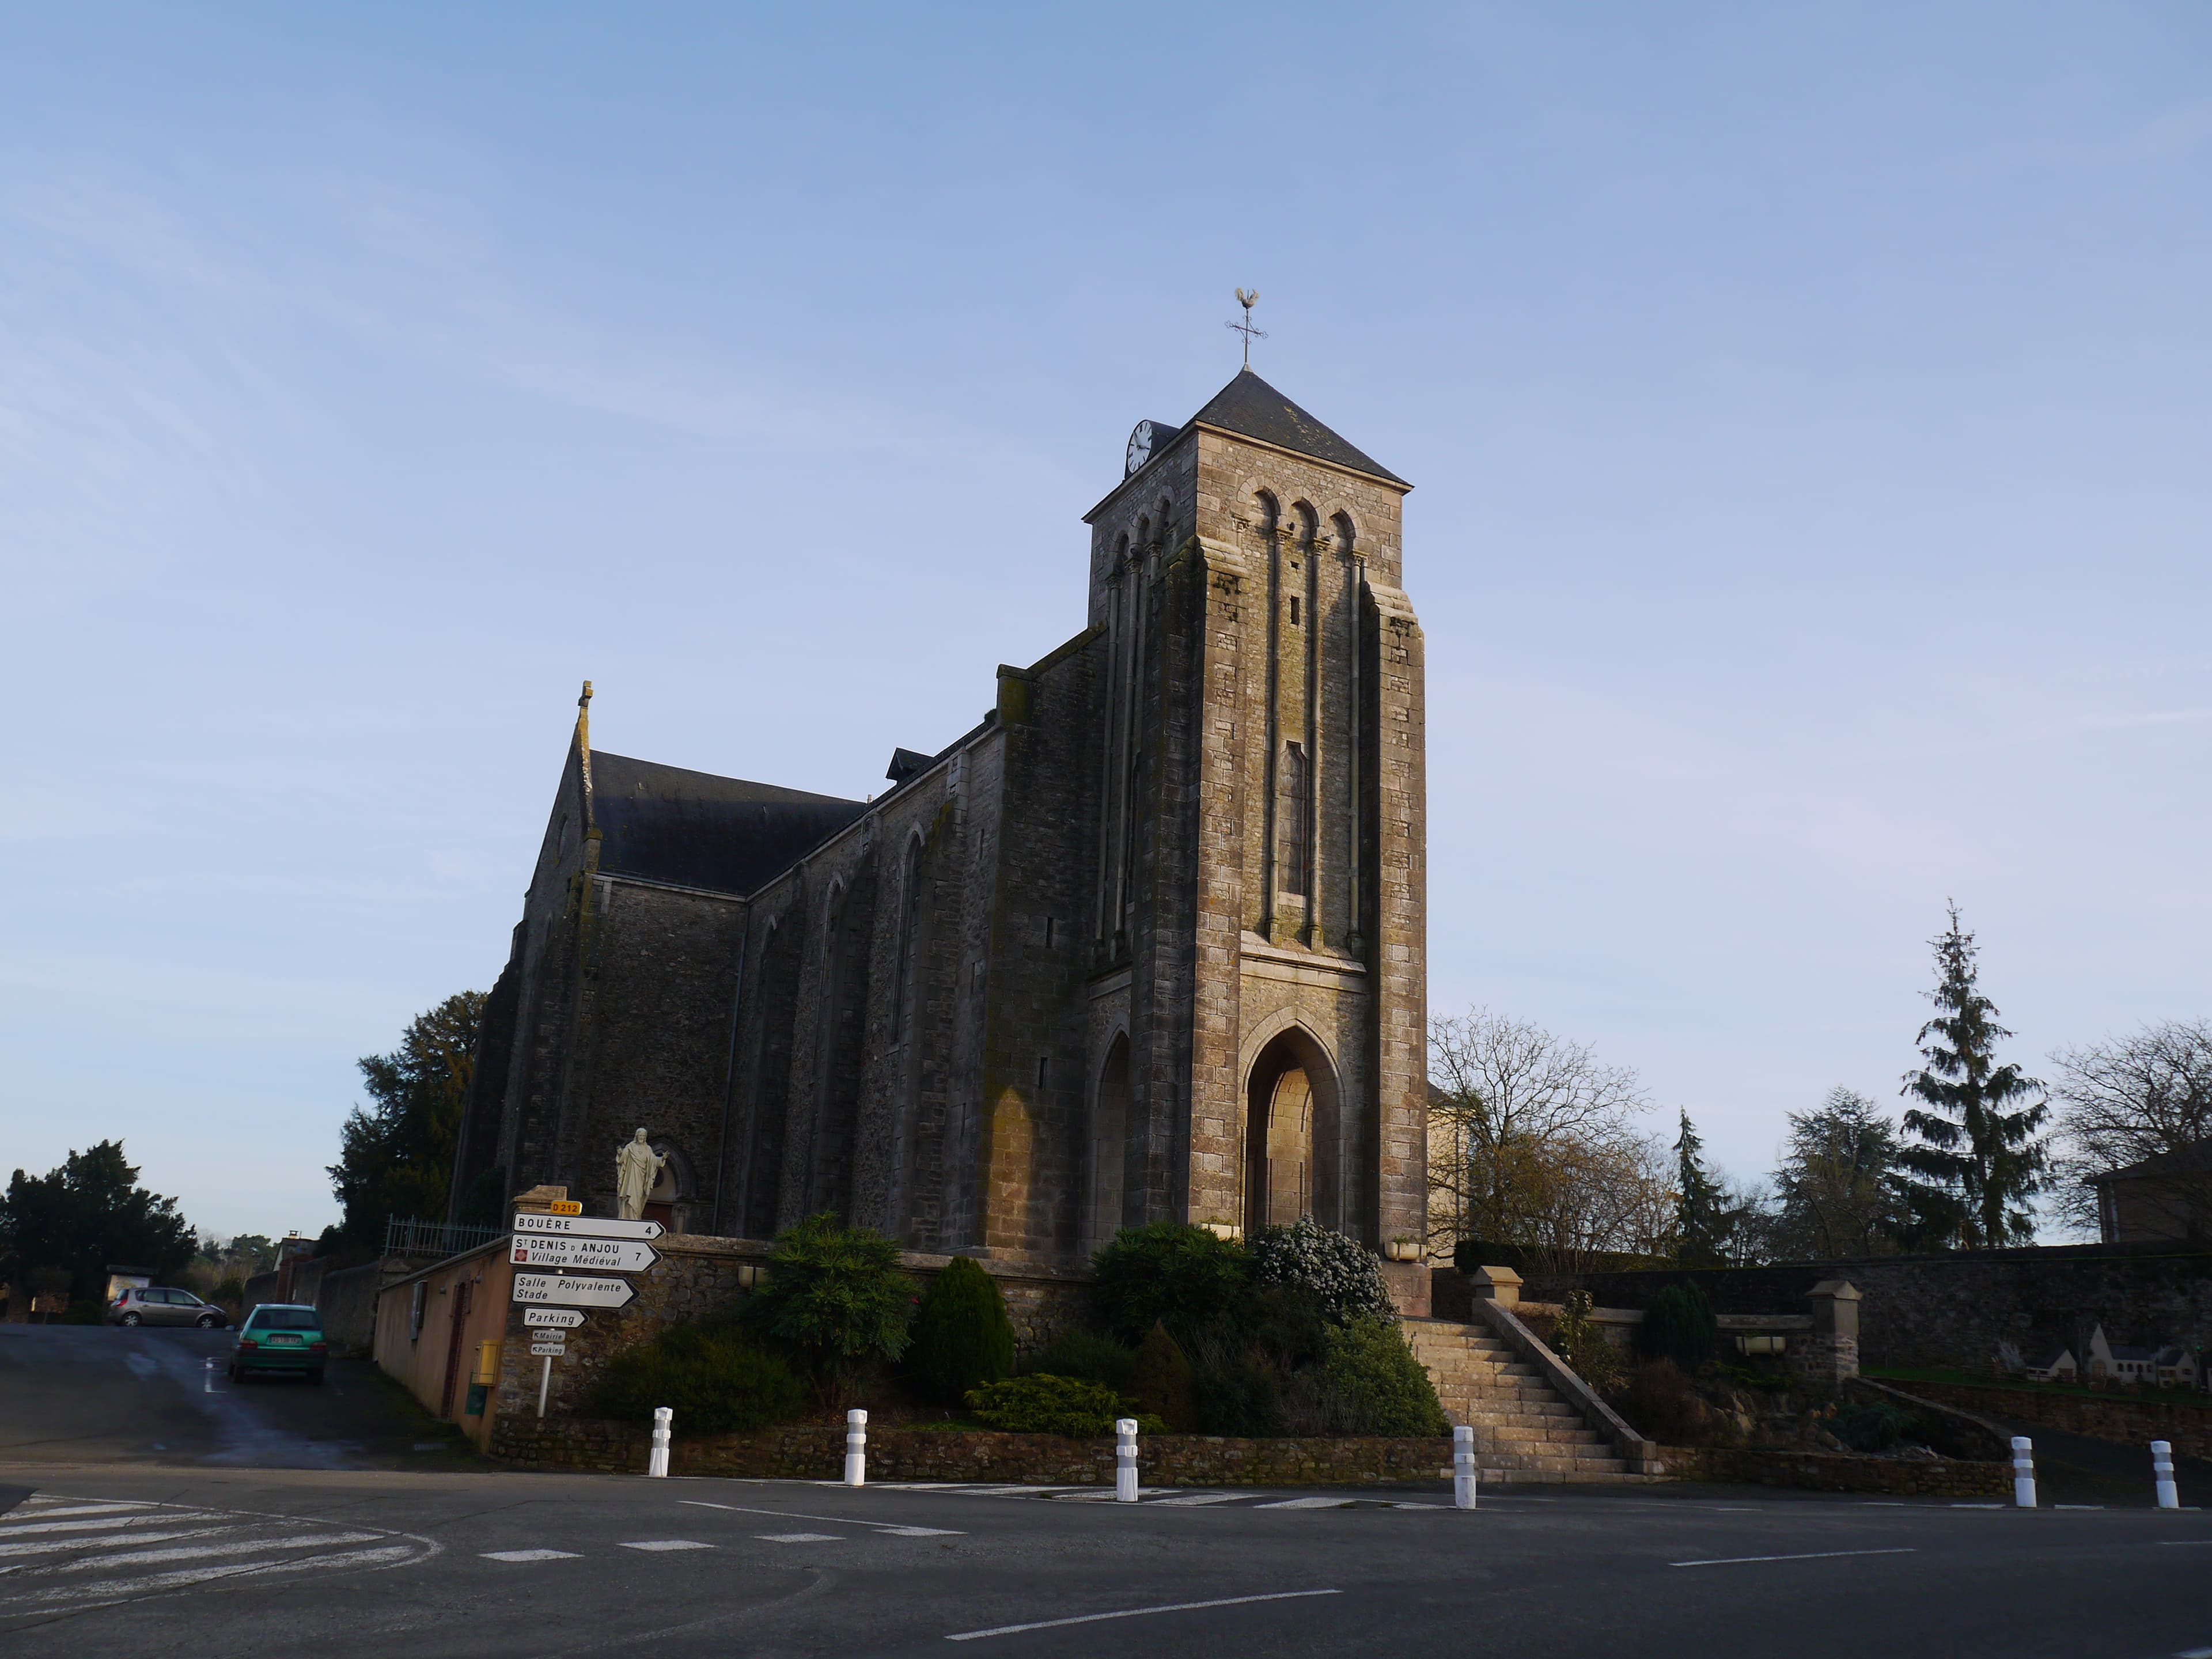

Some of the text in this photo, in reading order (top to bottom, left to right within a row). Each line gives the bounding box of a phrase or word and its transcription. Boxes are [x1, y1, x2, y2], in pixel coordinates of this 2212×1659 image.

[519, 1218, 652, 1234] BOUÈRE 4
[531, 1240, 566, 1251] DENIS
[581, 1243, 619, 1253] ANJOU
[532, 1252, 621, 1266] Village Médiéval
[635, 1253, 641, 1261] 7
[519, 1278, 621, 1292] Salle Polyvalente
[517, 1289, 548, 1300] Stade
[529, 1313, 574, 1325] Parking
[538, 1346, 562, 1354] Parking
